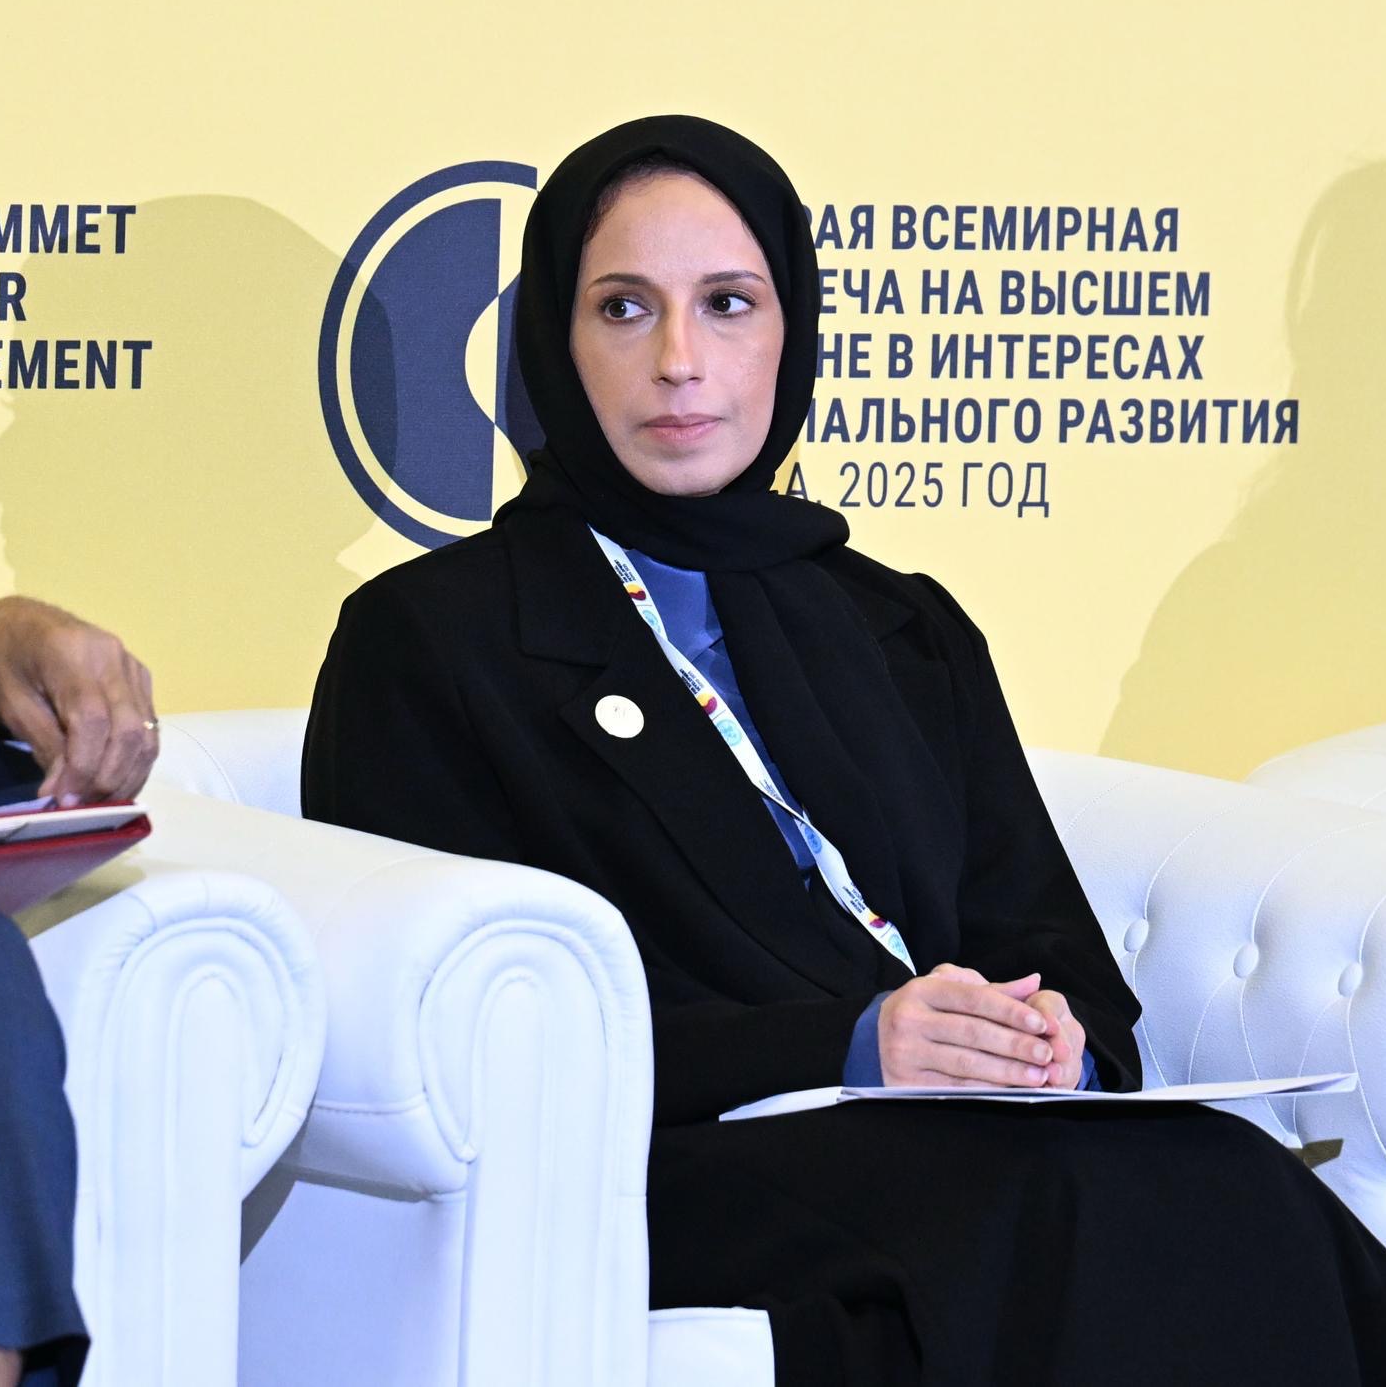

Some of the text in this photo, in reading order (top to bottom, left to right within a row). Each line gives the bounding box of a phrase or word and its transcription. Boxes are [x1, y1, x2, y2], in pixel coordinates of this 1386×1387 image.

[803, 204, 1179, 253] АЯ ВСЕМИРНАЯ
[921, 269, 984, 315] НА
[1000, 269, 1211, 317] ВЫСШЕМ
[887, 333, 914, 379] В
[930, 333, 1205, 381] ИНТЕРЕСАХ
[1058, 398, 1300, 445] РАЗВИТИЯ
[839, 461, 944, 508] 2025
[961, 461, 1050, 518] ГОД
